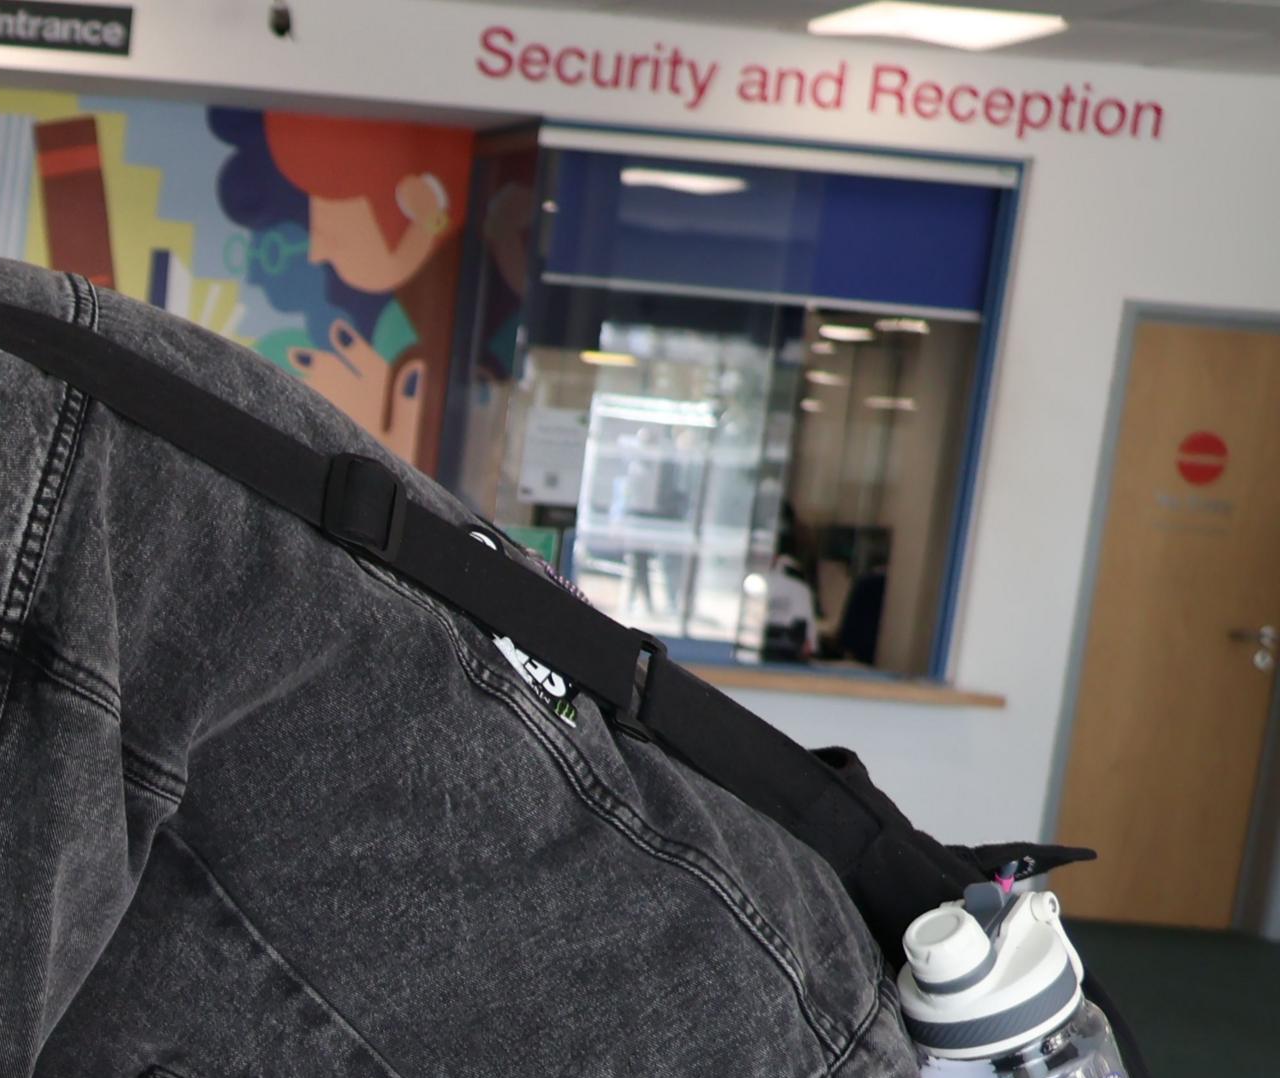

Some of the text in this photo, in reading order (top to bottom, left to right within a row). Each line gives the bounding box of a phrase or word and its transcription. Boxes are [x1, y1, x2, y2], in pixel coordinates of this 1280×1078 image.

[476, 26, 1164, 141] Security and Reception
